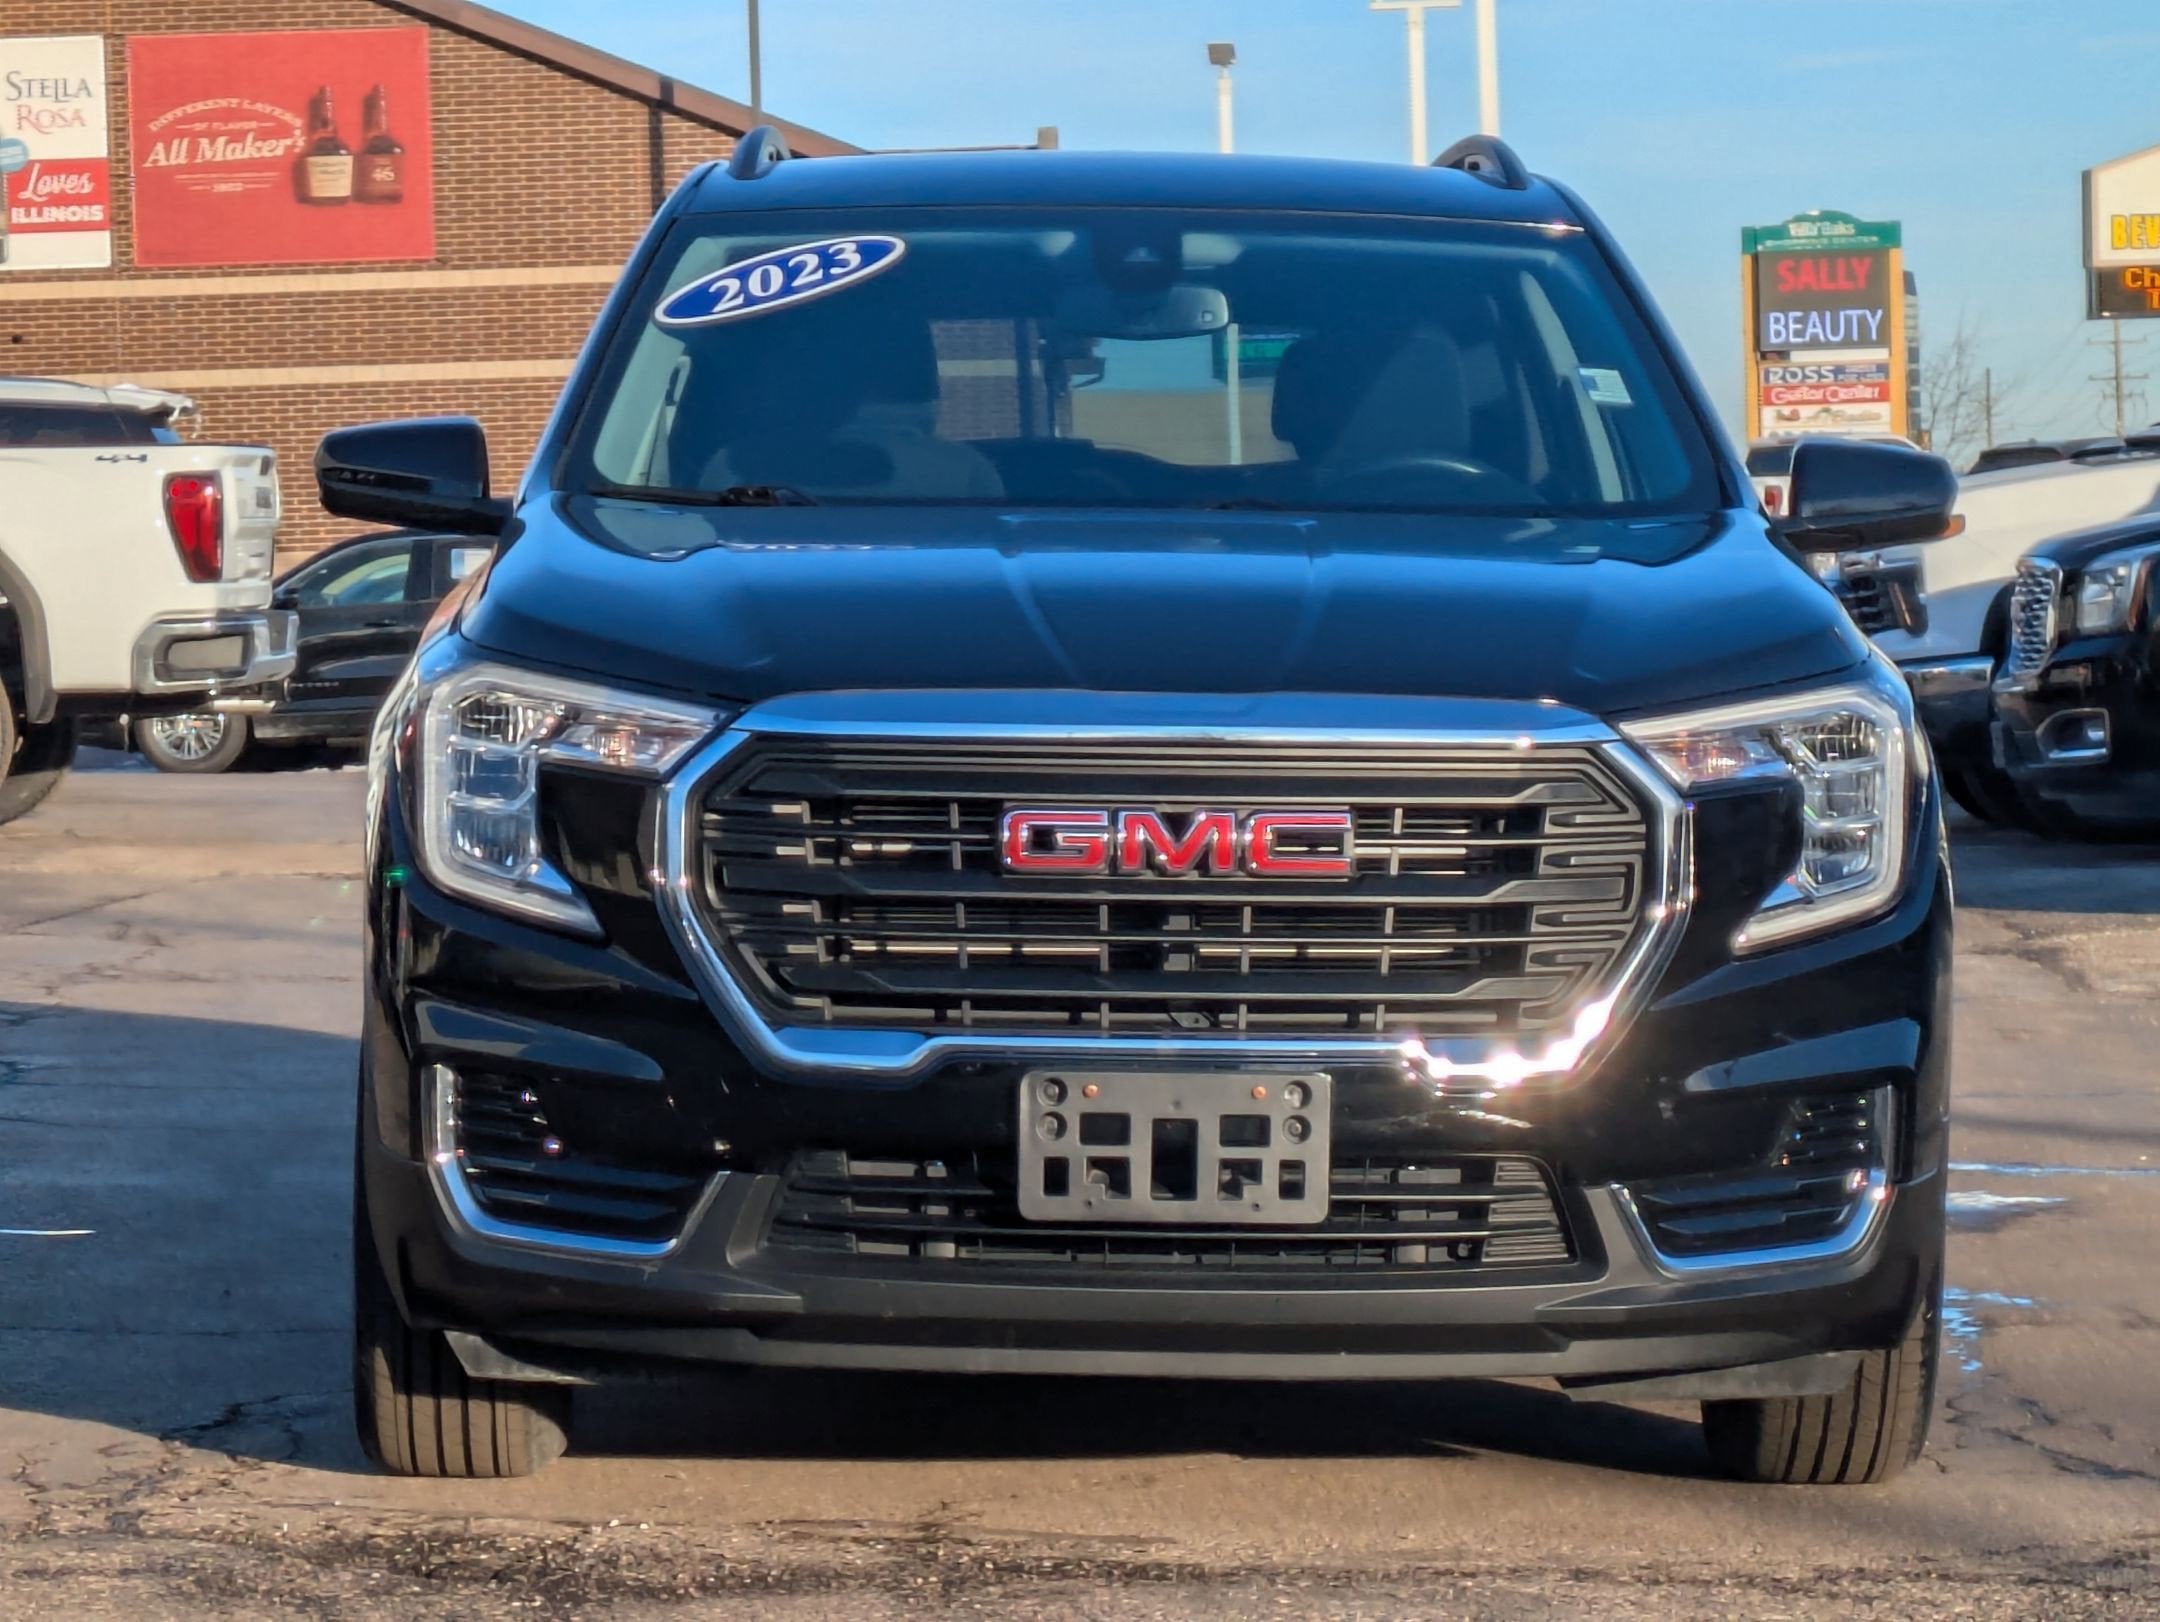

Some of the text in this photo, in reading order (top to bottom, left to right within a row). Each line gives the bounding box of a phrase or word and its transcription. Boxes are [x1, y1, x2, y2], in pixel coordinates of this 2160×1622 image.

[5, 70, 93, 103] STELLA
[16, 104, 87, 135] ROSA
[142, 137, 191, 167] All
[17, 162, 96, 202] Loves
[11, 205, 105, 224] ILLINOIS
[708, 242, 861, 313] 2023
[1777, 256, 1873, 292] SALLY
[1768, 309, 1883, 344] BEAUTY
[1768, 366, 1836, 384] ROSS
[1000, 806, 1354, 875] GMC
